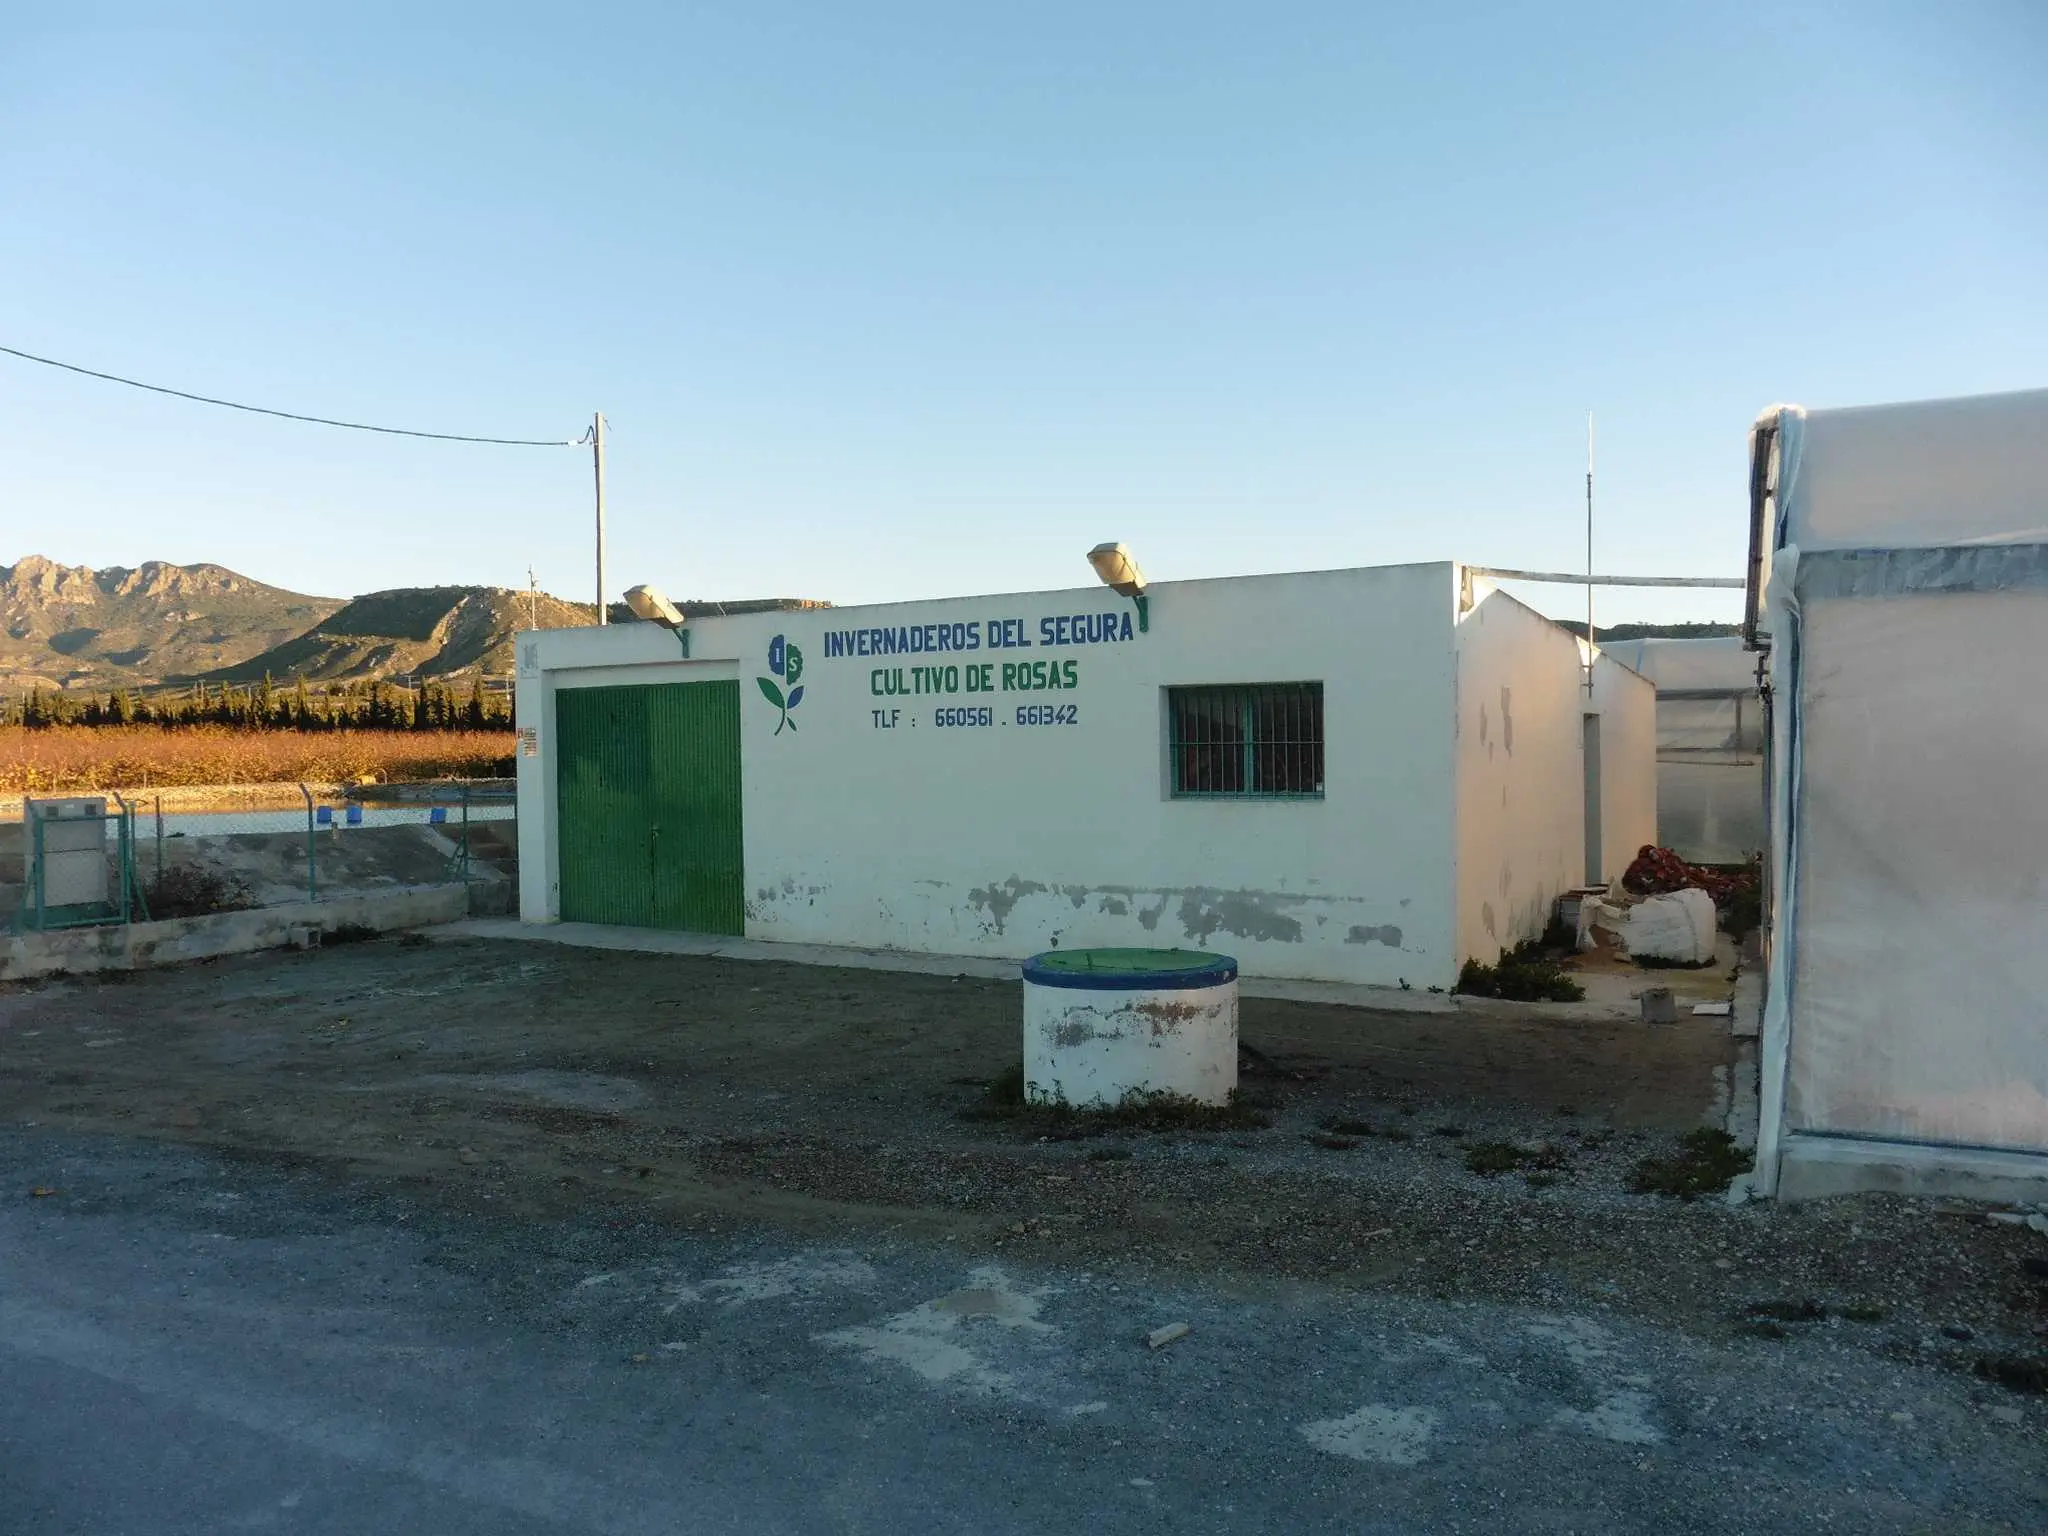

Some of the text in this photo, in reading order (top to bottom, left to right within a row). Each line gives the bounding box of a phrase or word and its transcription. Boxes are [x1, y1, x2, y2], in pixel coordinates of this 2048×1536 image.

[823, 611, 1135, 658] INVERNADEROS DEL SEGURA
[870, 659, 1080, 696] CULTIVO DE ROSAS
[934, 706, 994, 728] 660561
[1015, 704, 1080, 727] 661342
